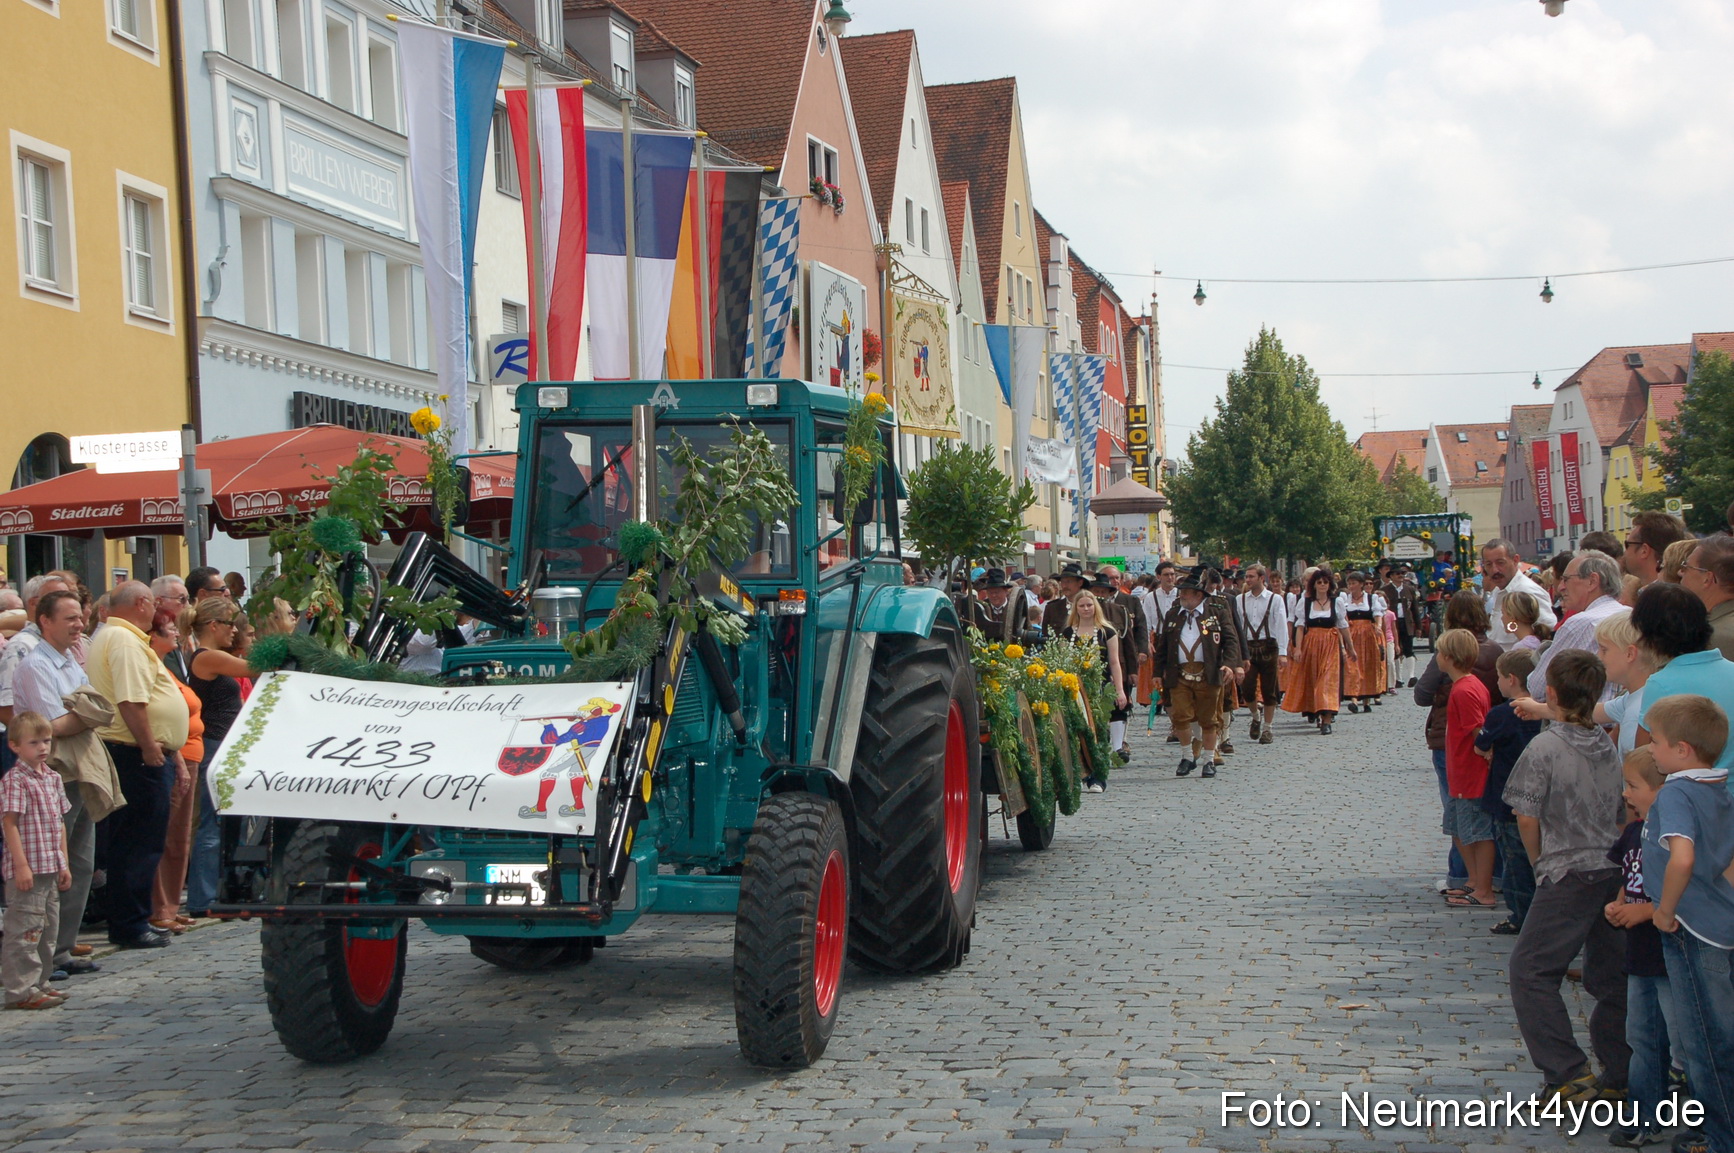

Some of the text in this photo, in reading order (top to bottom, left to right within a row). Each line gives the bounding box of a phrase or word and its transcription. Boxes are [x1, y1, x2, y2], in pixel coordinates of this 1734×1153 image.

[290, 140, 396, 211] BRILLEN WEBER
[79, 440, 168, 457] Klostergasse
[1565, 460, 1582, 514] REDUZIERT
[50, 502, 124, 521] Stadtcafé
[145, 514, 184, 523] Stadtca
[236, 505, 284, 517] Stadtcafé
[310, 686, 525, 718] Schützengesellschaft
[364, 724, 402, 734] von
[306, 736, 436, 769] 1433
[244, 769, 400, 801] Neumarkt
[500, 869, 521, 883] NM
[1626, 872, 1644, 893] 22
